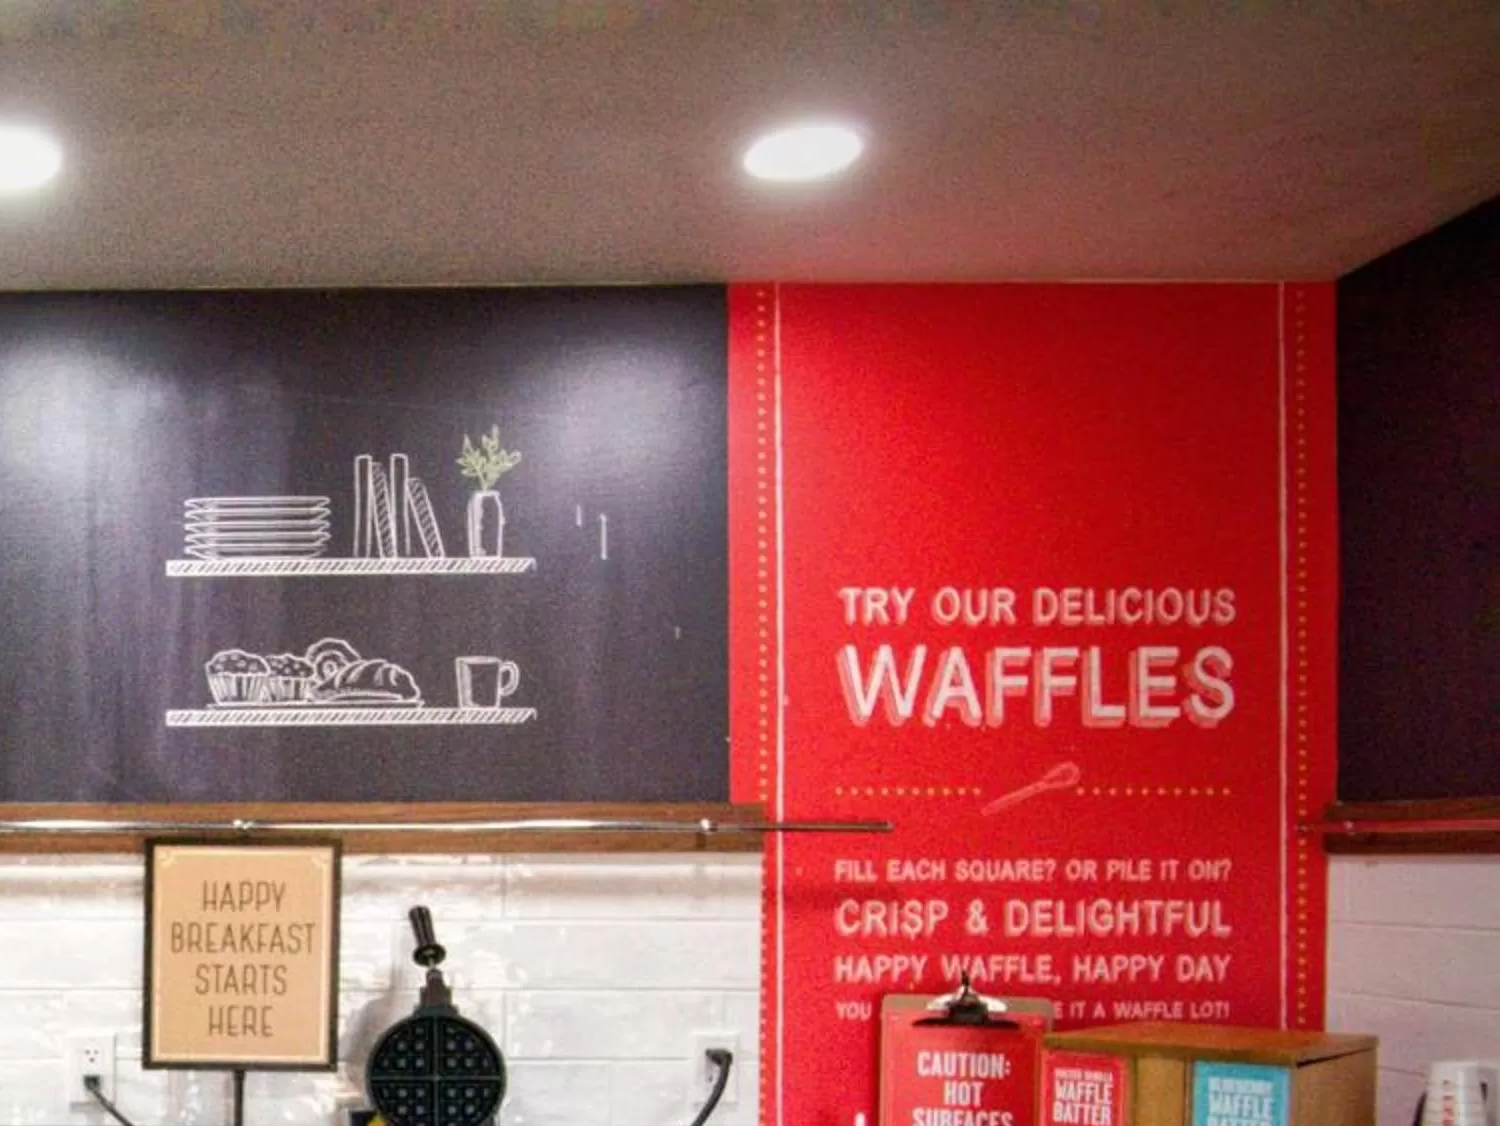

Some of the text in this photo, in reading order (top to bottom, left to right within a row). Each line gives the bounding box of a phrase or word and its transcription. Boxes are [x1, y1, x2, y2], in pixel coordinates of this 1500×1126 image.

[838, 586, 1237, 626] TRY OUR DELICIOUS
[835, 643, 1236, 728] WAFFLES
[834, 859, 1232, 882] FILL EACH SQUARE? OR PILE IT ON?
[202, 879, 286, 913] HAPPY
[834, 898, 1233, 938] CRISP & DELIGHTFUL
[170, 920, 316, 956] BREAKFAST
[195, 963, 288, 996] STARTS
[834, 954, 1231, 986] HAPPY WAFFLE, HAPPY DAY
[208, 1005, 274, 1037] HERE
[836, 1003, 872, 1020] YOU
[1070, 1003, 1084, 1019] IT
[1093, 1003, 1105, 1019] A
[1113, 1003, 1184, 1020] WAFFLE
[1190, 1003, 1230, 1020] LOT!
[916, 1050, 1011, 1080] CAUTION:
[944, 1080, 984, 1108] HOT
[1055, 1079, 1114, 1105] WAFFLE
[1208, 1091, 1274, 1120] WAFFLE
